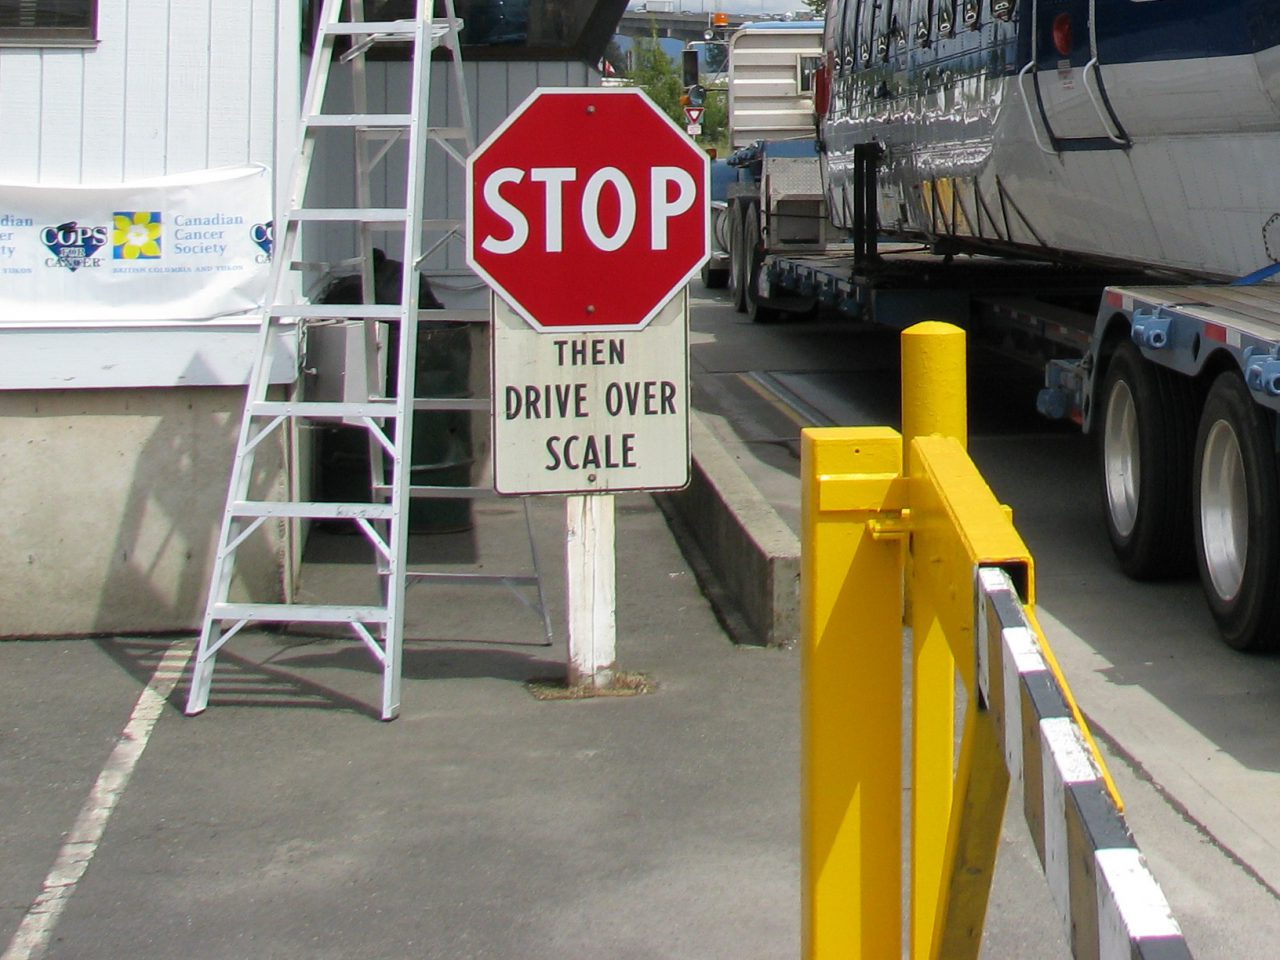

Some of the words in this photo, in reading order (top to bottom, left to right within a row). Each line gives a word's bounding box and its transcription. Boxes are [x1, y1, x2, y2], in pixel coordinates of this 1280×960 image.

[174, 213, 244, 227] Canadian
[481, 166, 697, 254] STOP
[40, 225, 108, 246] COPS
[174, 229, 225, 241] Cancer
[60, 247, 86, 257] FOR
[174, 243, 228, 257] Society
[553, 339, 626, 366] THEN
[505, 382, 589, 420] DRIVE
[605, 380, 677, 417] OVER
[545, 433, 637, 471] SCALE
